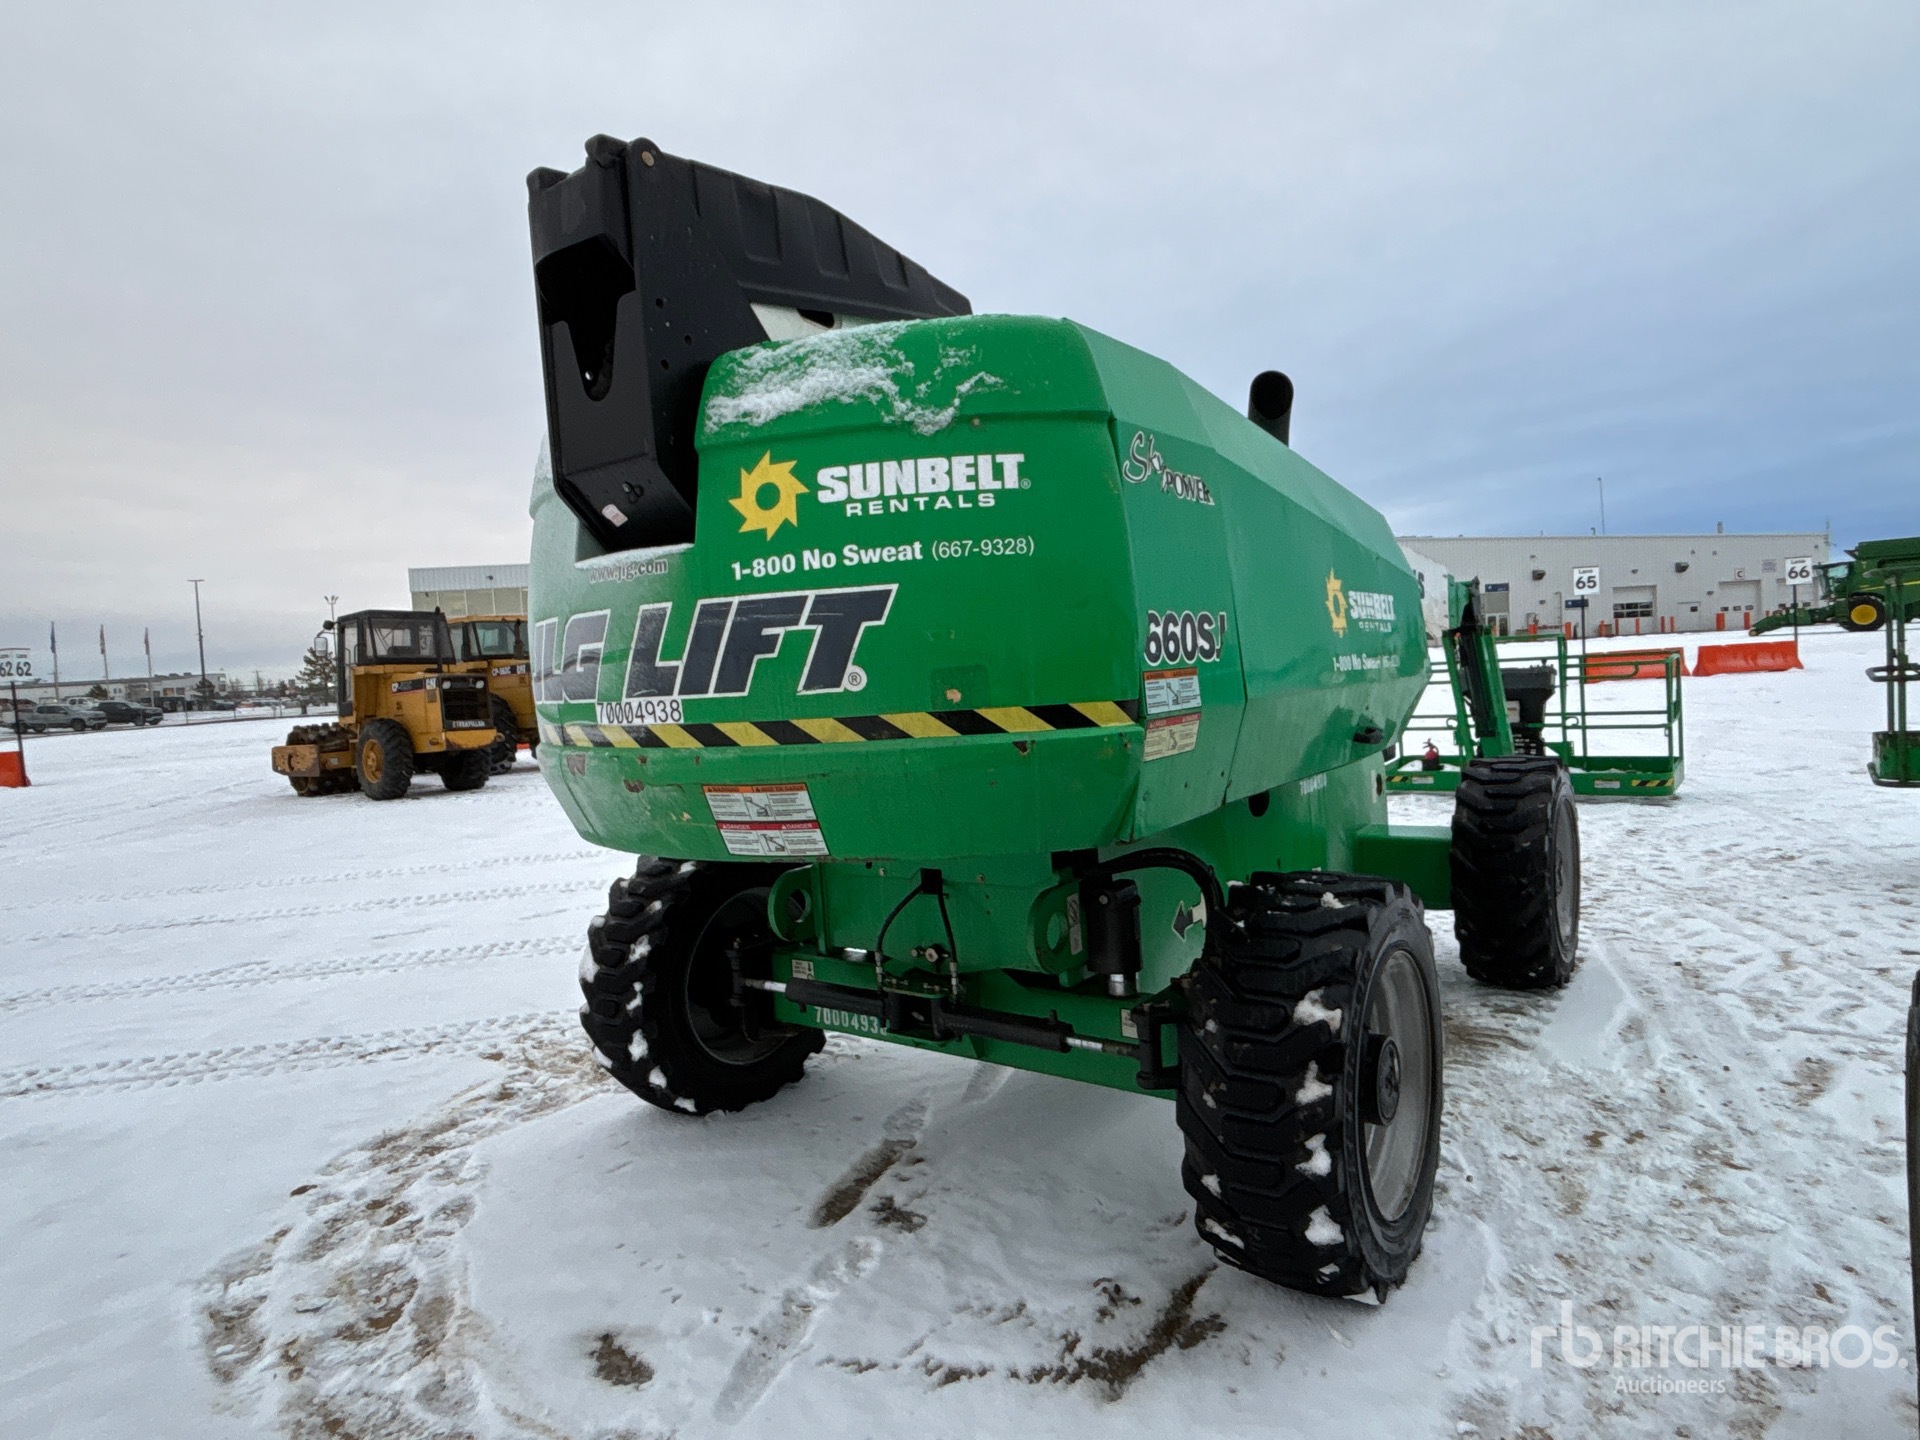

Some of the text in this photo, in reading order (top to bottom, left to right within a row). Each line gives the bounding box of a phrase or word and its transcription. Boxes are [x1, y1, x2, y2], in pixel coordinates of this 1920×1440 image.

[817, 454, 1025, 503] SUNBELT
[846, 493, 995, 517] RENTALS
[731, 536, 1035, 580] 1-800 No Sweat (667-9328)
[1575, 575, 1597, 590] 65
[1788, 566, 1810, 579] 66
[1348, 590, 1395, 620] SUNBELT
[622, 583, 899, 700] LIFT
[1144, 610, 1227, 667] 660SJ
[0, 661, 33, 677] 62 62
[597, 699, 682, 724] 70004938
